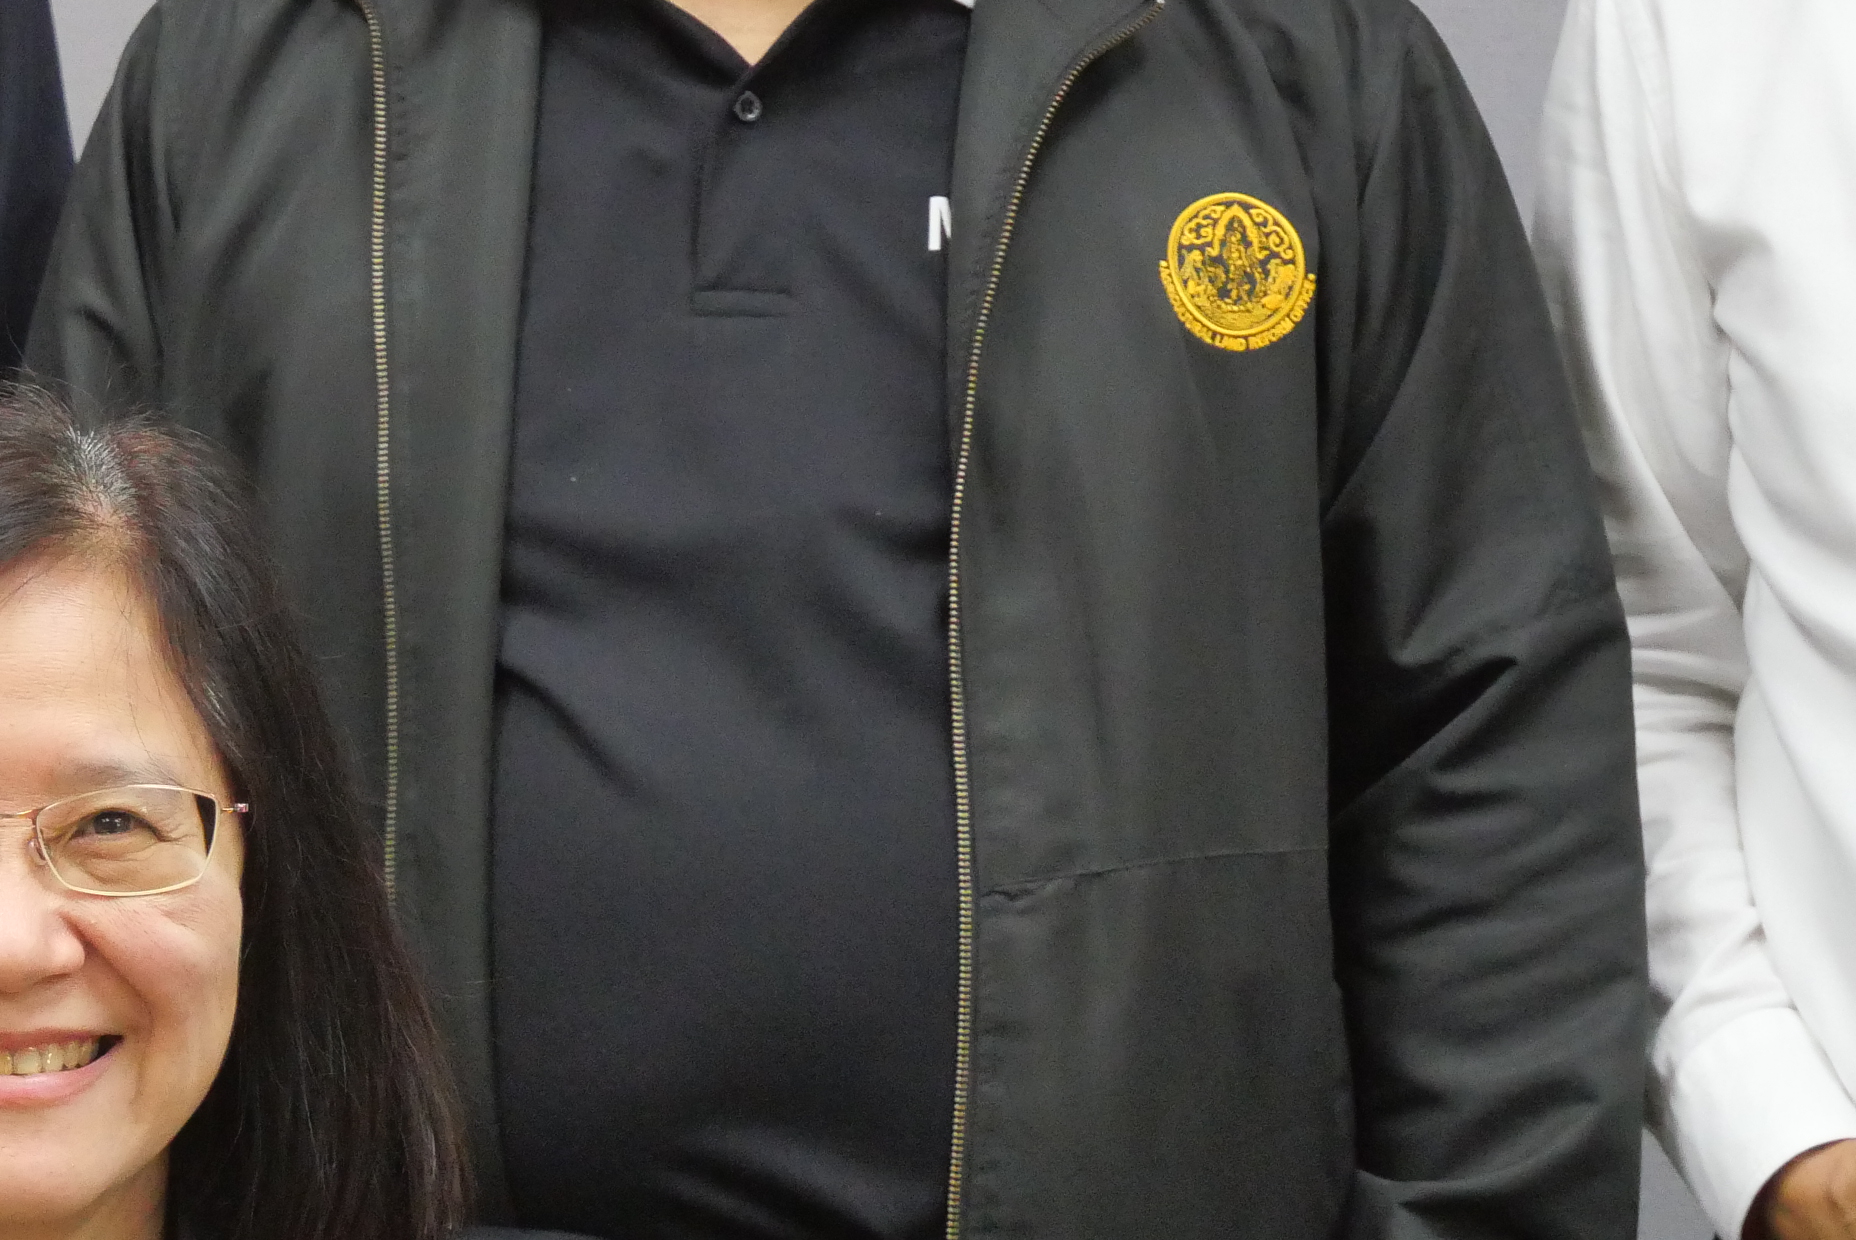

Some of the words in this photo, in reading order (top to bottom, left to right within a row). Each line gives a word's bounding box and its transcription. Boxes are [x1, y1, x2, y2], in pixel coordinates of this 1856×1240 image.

[1214, 333, 1247, 352] LAND
[1247, 316, 1296, 350] REFORM
[1289, 279, 1317, 323] OFFICE
